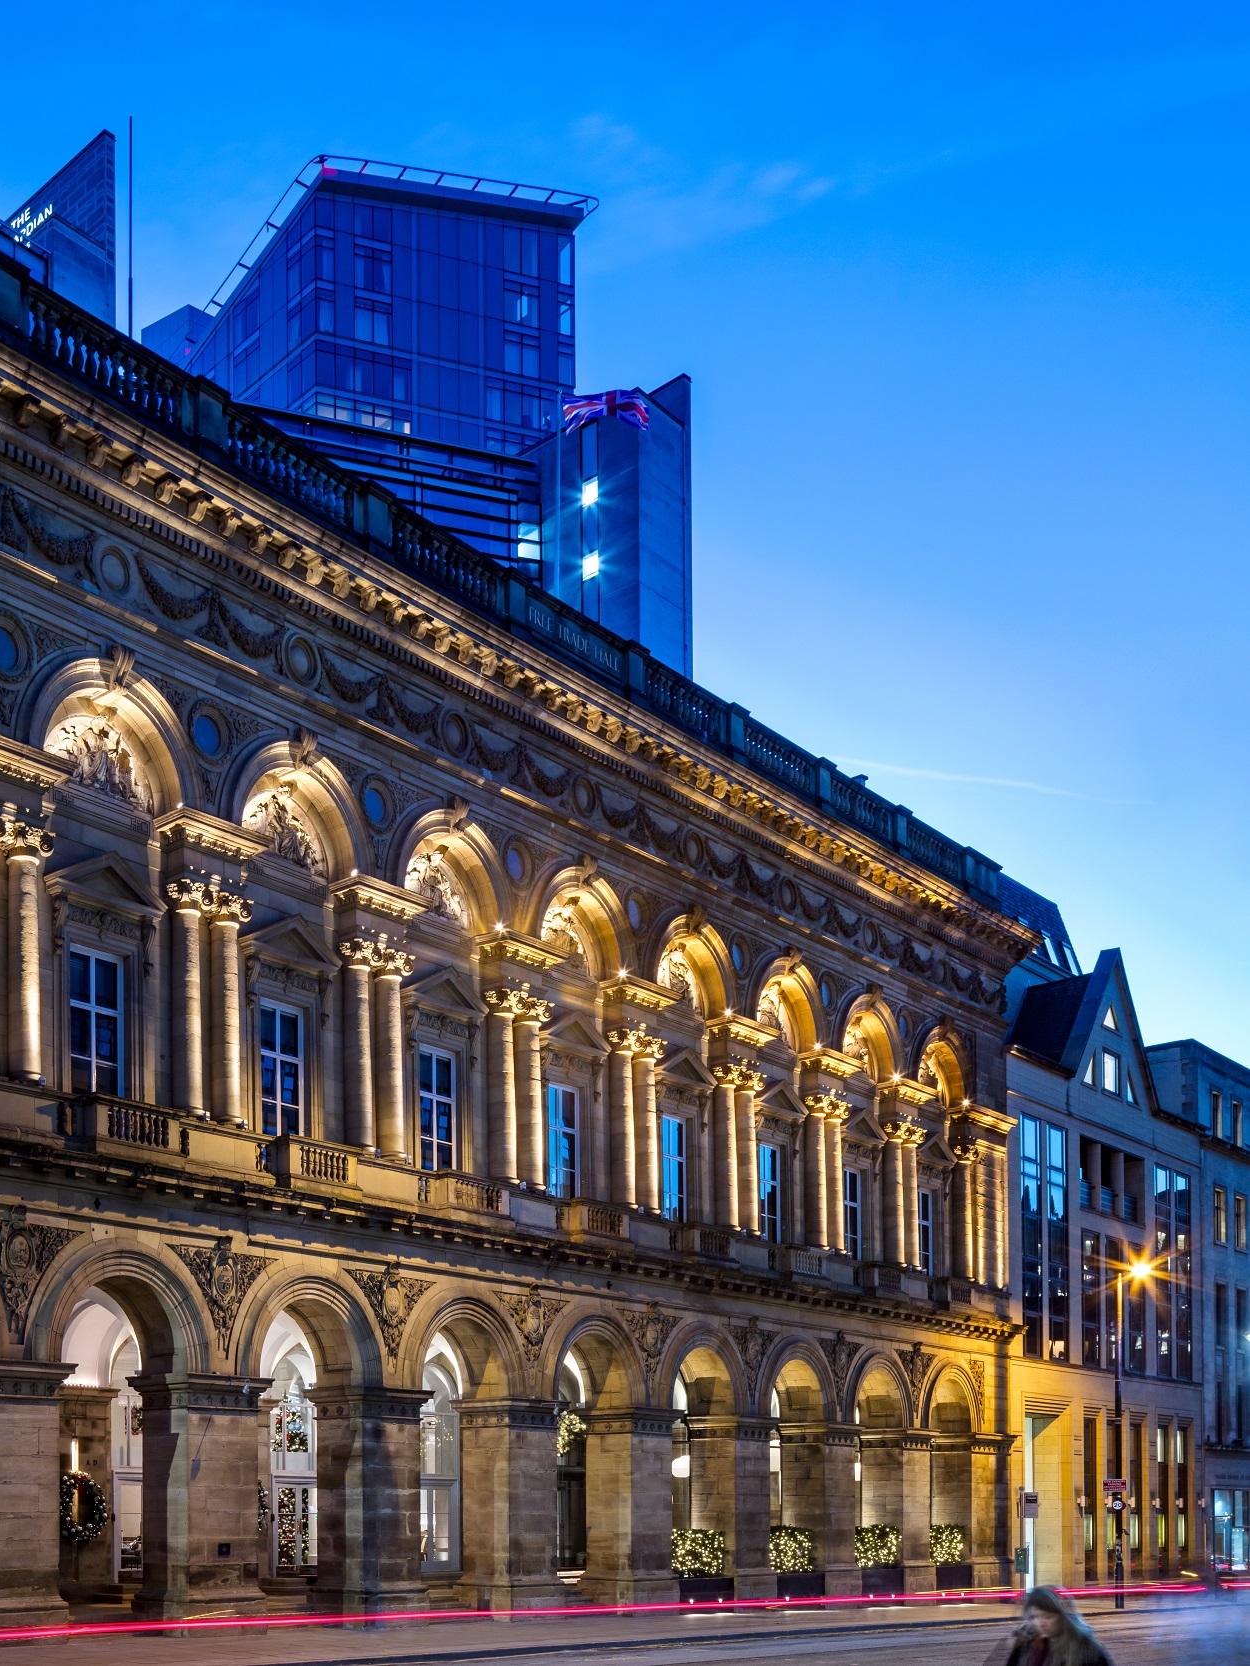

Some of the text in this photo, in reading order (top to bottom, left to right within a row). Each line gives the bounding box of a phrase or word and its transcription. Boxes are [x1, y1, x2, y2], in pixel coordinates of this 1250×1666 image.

[11, 208, 31, 228] THE
[529, 606, 620, 672] FREE TRADE HALL
